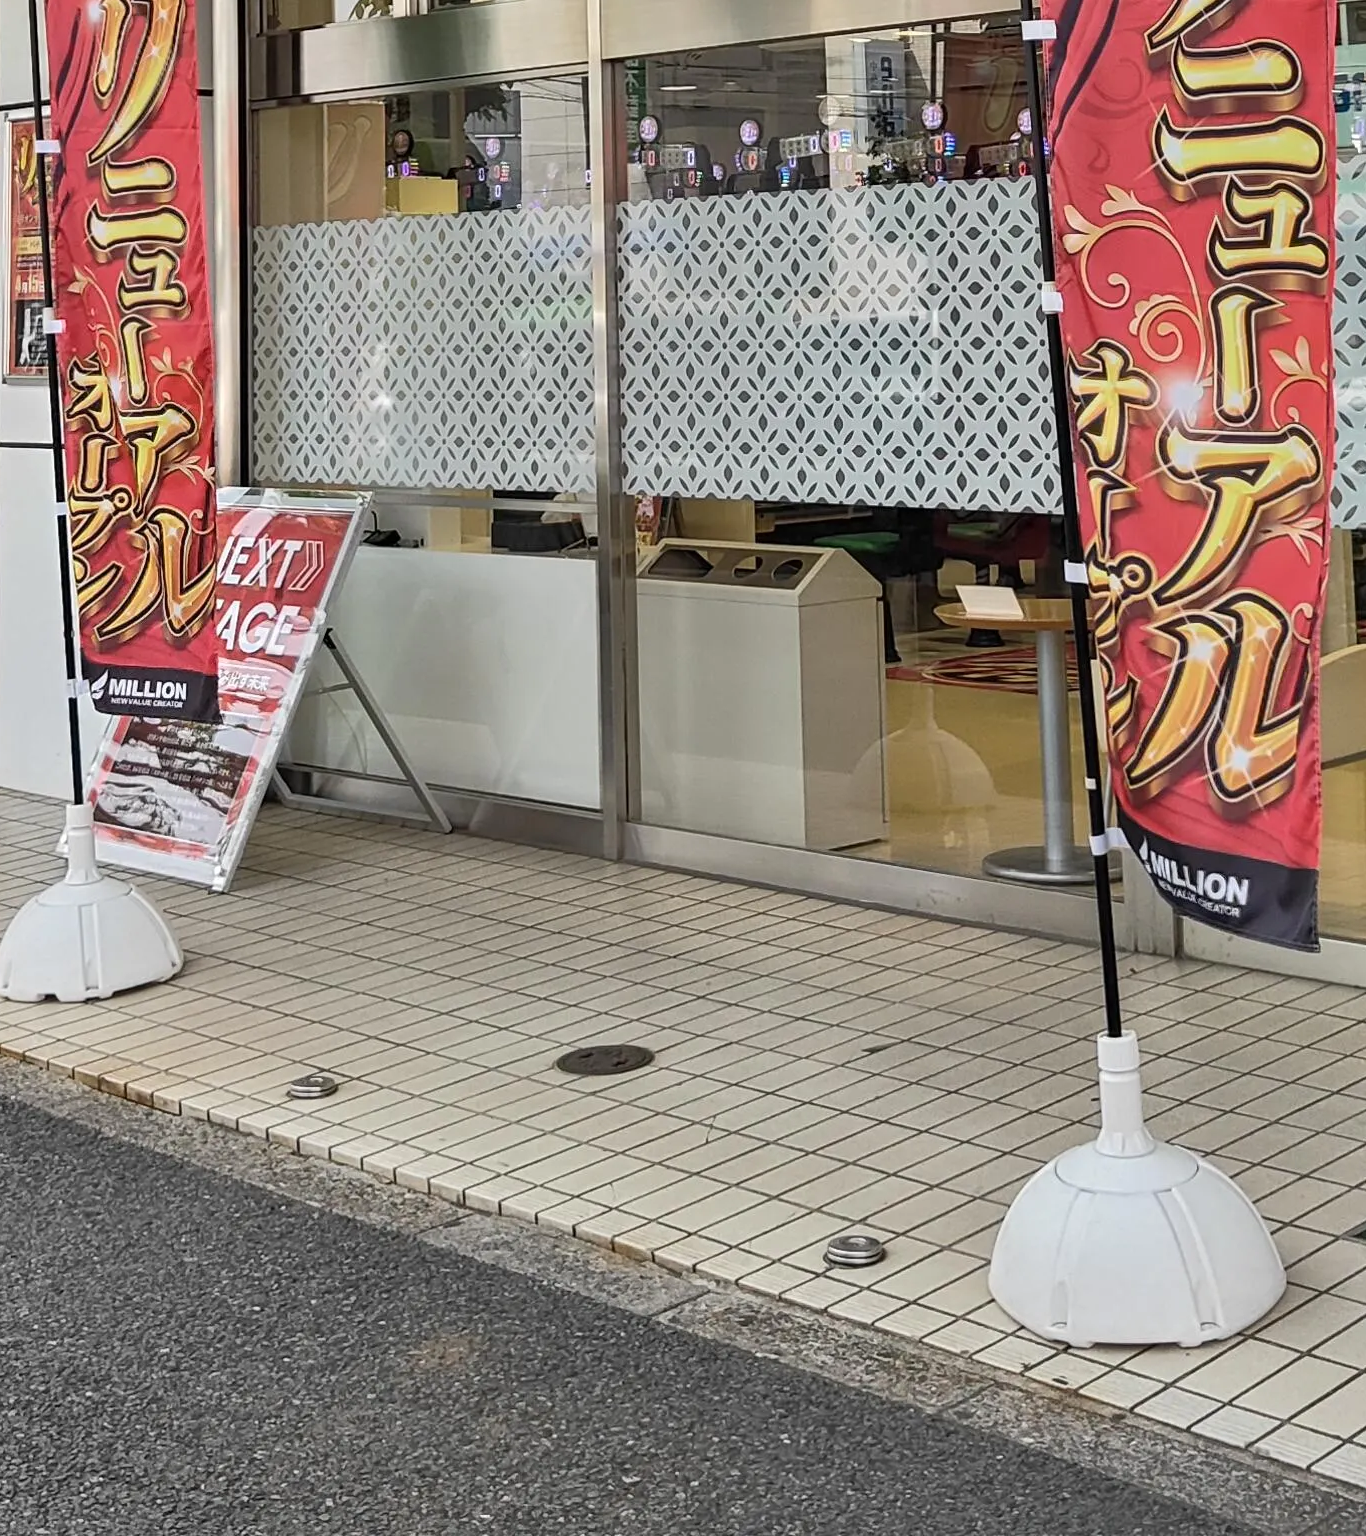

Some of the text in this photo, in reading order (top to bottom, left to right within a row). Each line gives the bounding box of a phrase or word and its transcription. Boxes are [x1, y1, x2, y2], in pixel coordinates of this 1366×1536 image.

[216, 598, 301, 656] AGE
[109, 678, 187, 700] MILLION
[111, 697, 183, 709] NEW VALUE CREATOR
[1150, 850, 1250, 906] MILLION
